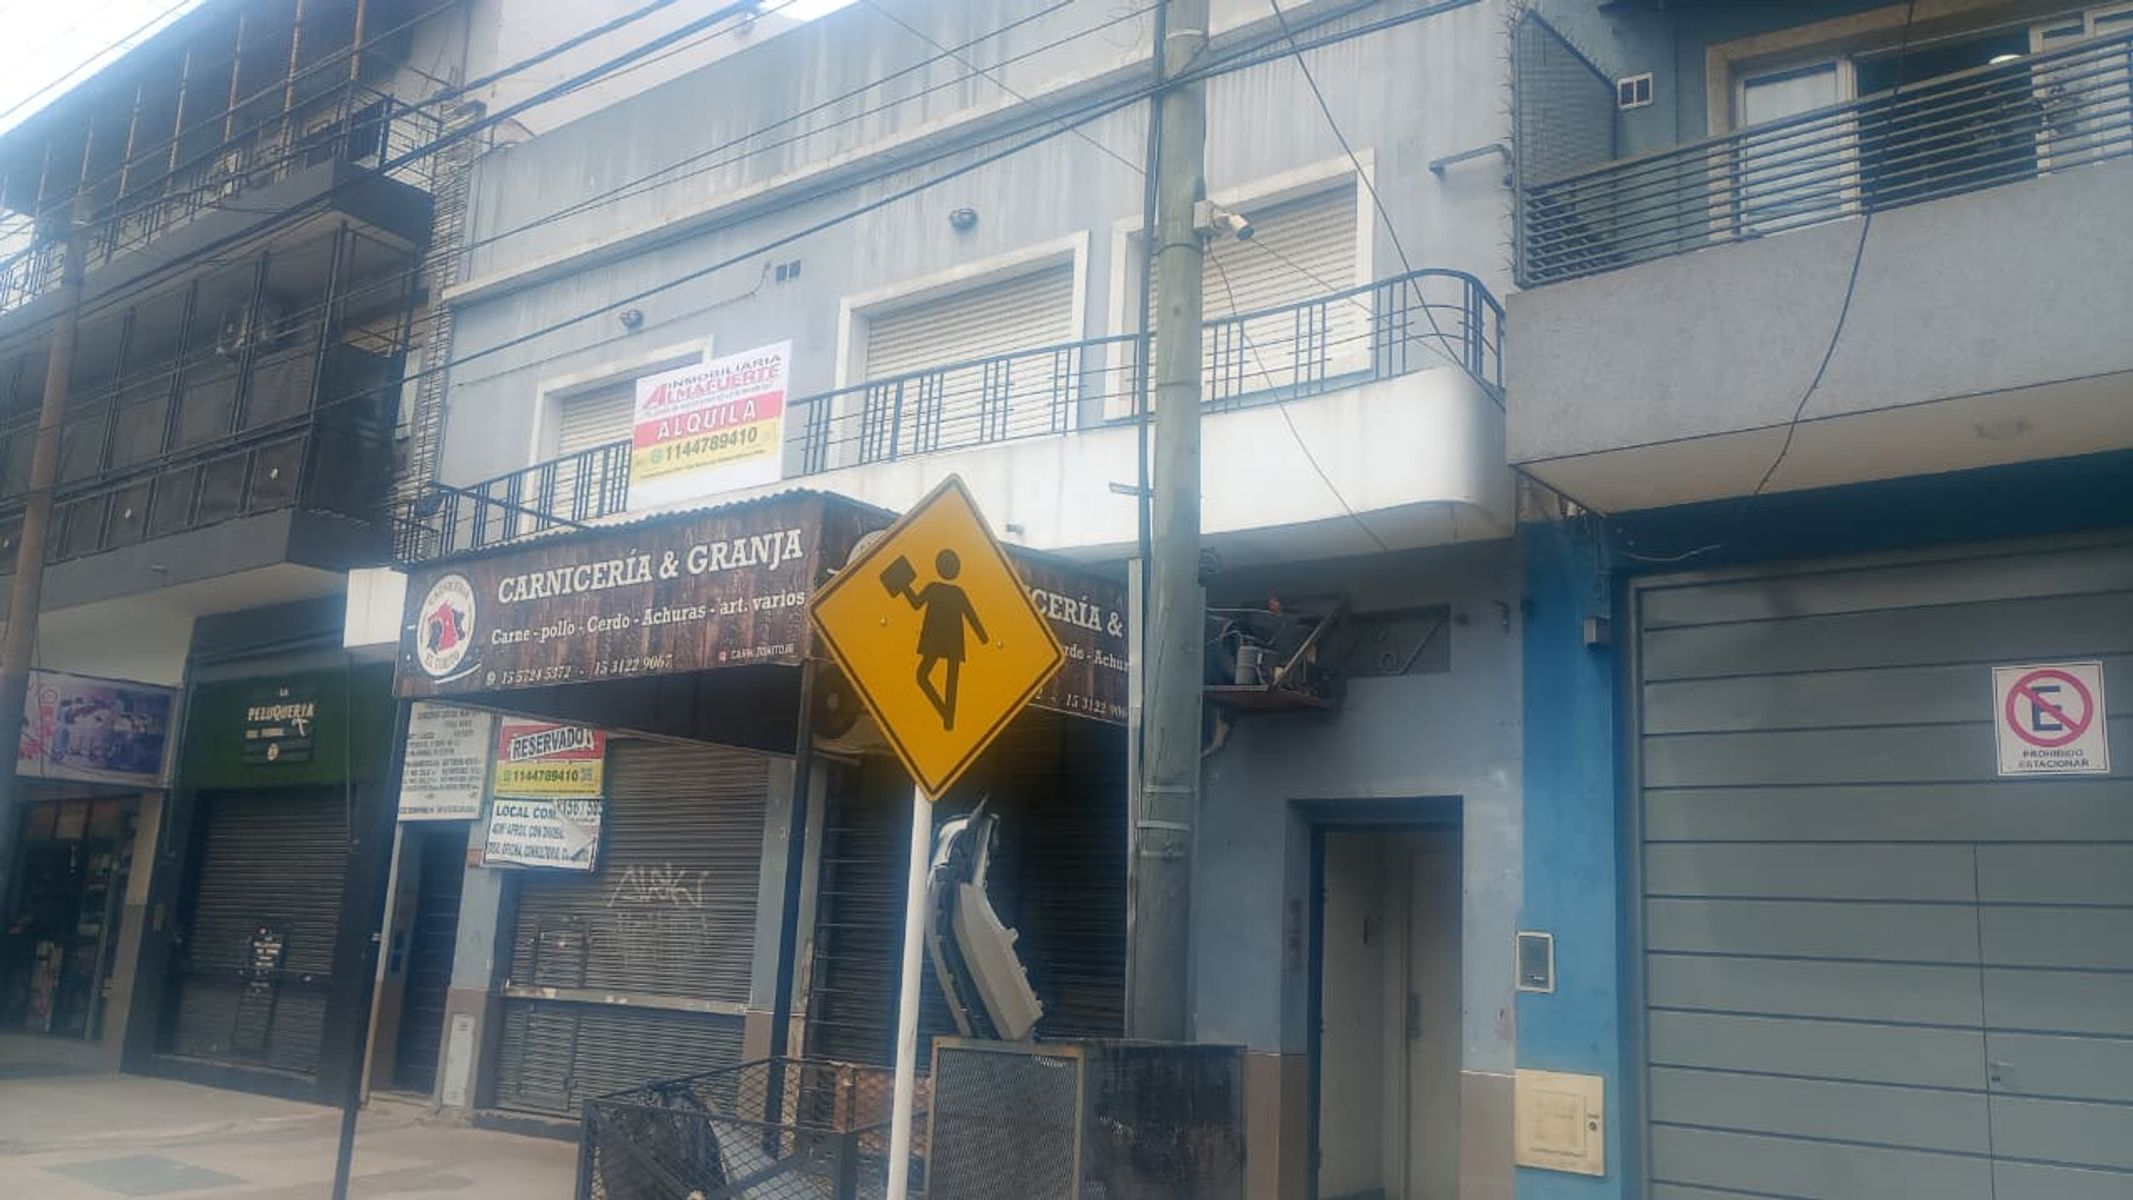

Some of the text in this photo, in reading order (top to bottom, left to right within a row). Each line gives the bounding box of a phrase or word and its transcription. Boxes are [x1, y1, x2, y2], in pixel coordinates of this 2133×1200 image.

[642, 362, 782, 410] ALMAFUERTE
[668, 354, 782, 388] INMOBILIARIA
[657, 399, 757, 441] ALQUILA
[666, 427, 758, 461] 1144789410
[498, 528, 803, 603] CARNICERÍA & GRANJA
[491, 629, 531, 645] Carne
[540, 620, 575, 643] pollo
[587, 613, 630, 633] Cerdo
[641, 607, 706, 626] Achuras
[719, 599, 748, 615] art.
[752, 590, 805, 610] varios
[1030, 587, 1123, 638] CERÍA &
[595, 661, 608, 675] 15
[611, 657, 640, 674] 3122
[1063, 643, 1084, 660] rdo
[512, 727, 583, 760] RESERVADO
[514, 769, 578, 783] 1144789410
[496, 804, 530, 818] LOCAL
